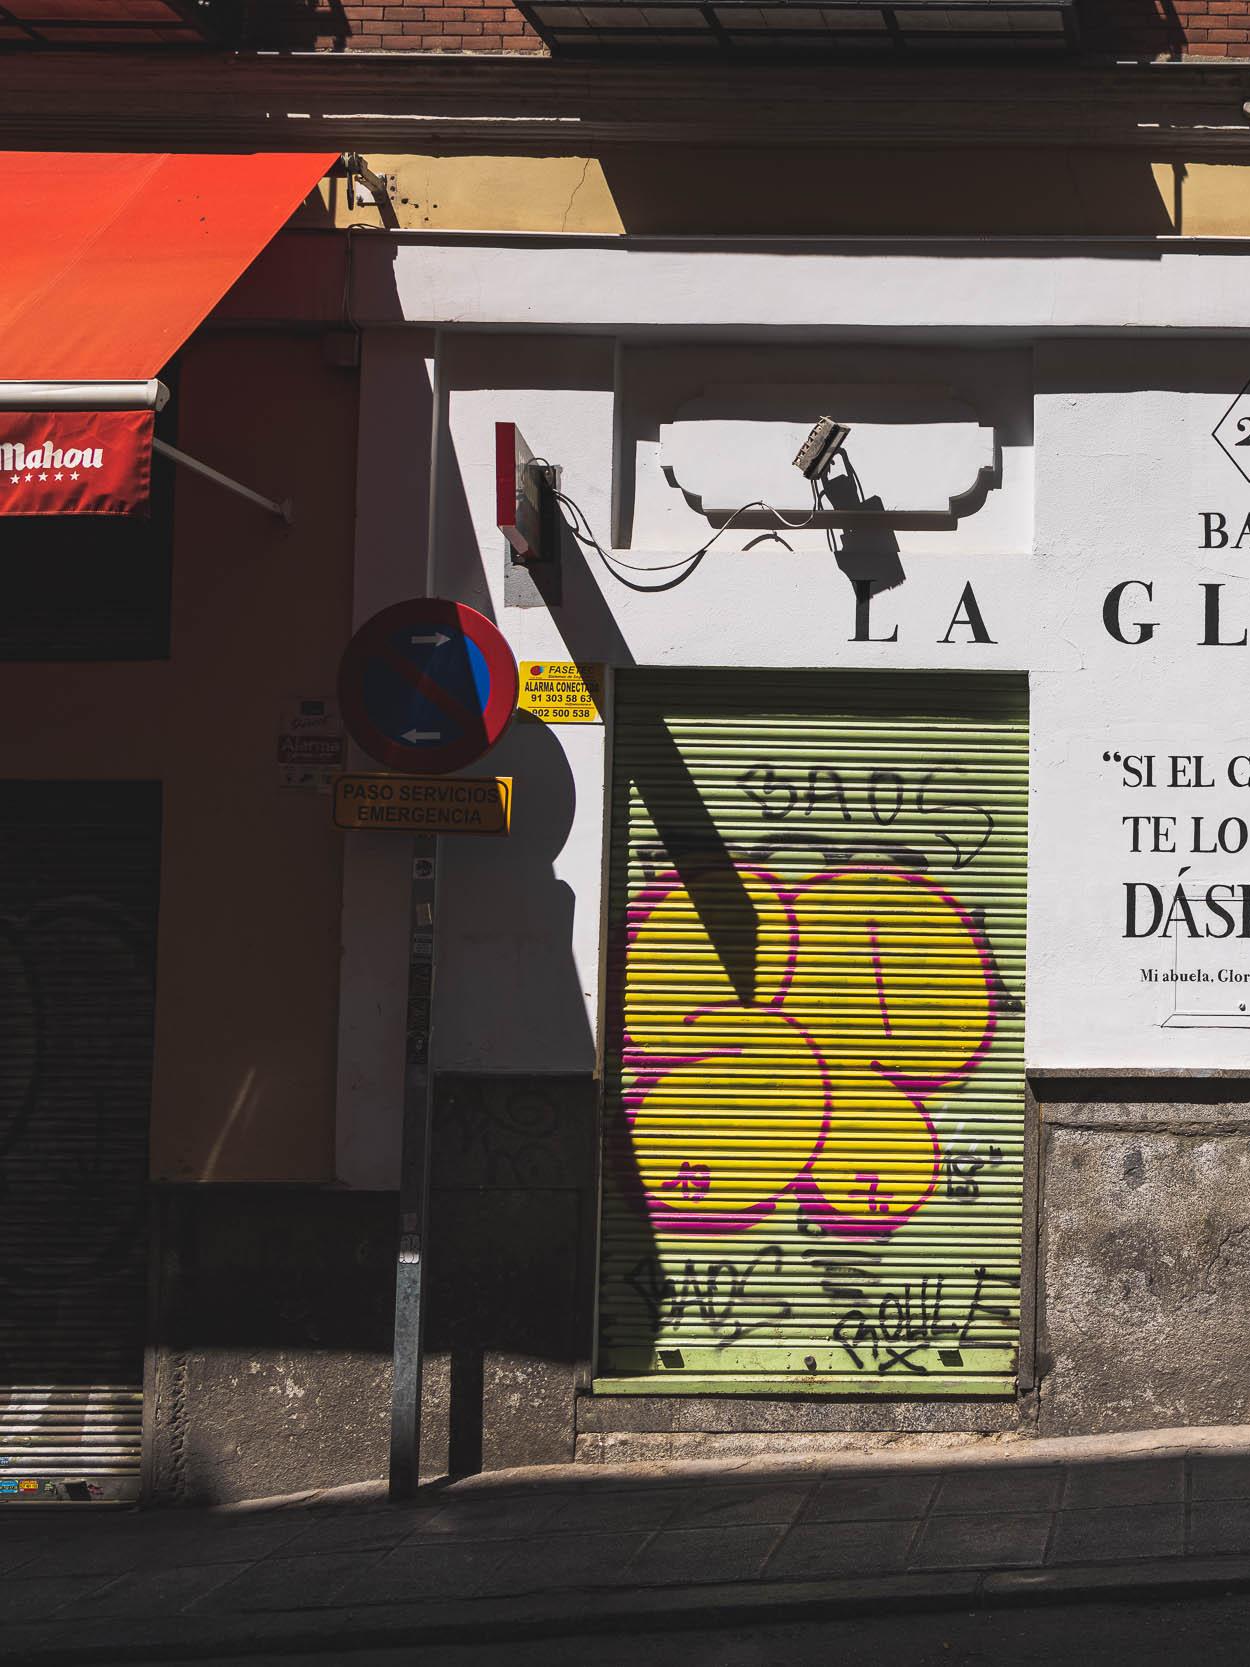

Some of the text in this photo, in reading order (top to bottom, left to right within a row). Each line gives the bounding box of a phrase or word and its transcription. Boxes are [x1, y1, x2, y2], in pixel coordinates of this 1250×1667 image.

[0, 440, 104, 472] Mahou
[847, 578, 998, 644] LA
[525, 681, 555, 693] ALARMA
[531, 694, 592, 703] 91 303 58 63
[532, 709, 590, 718] 902 500 538
[1103, 751, 1157, 788] “SI
[1168, 755, 1215, 788] EL
[343, 783, 500, 803] PASO SERVICIOS
[357, 805, 483, 825] EMERGENCIA
[1122, 816, 1177, 853] TE
[1189, 816, 1249, 854] LO
[1140, 968, 1159, 983] Mi
